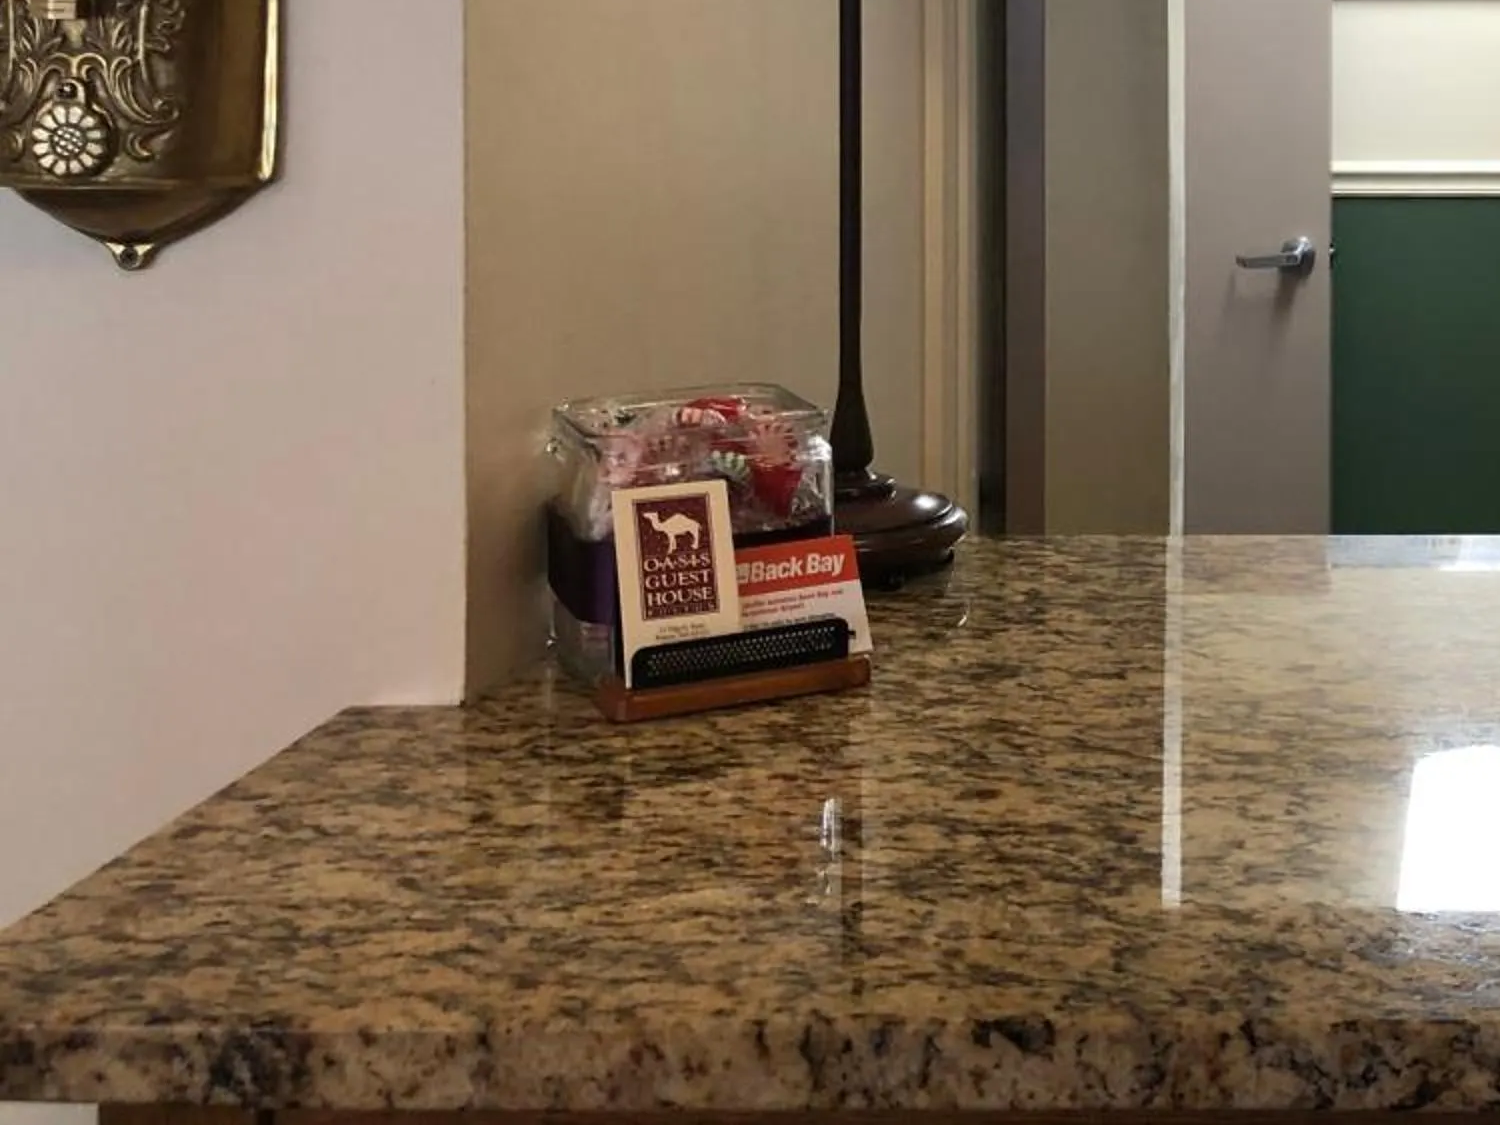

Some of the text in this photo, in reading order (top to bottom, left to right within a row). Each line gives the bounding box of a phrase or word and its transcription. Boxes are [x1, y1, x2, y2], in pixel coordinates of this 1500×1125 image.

[750, 555, 804, 583] Back
[805, 552, 846, 577] Bay
[645, 568, 711, 590] GUEST
[647, 586, 714, 606] HOUSE
